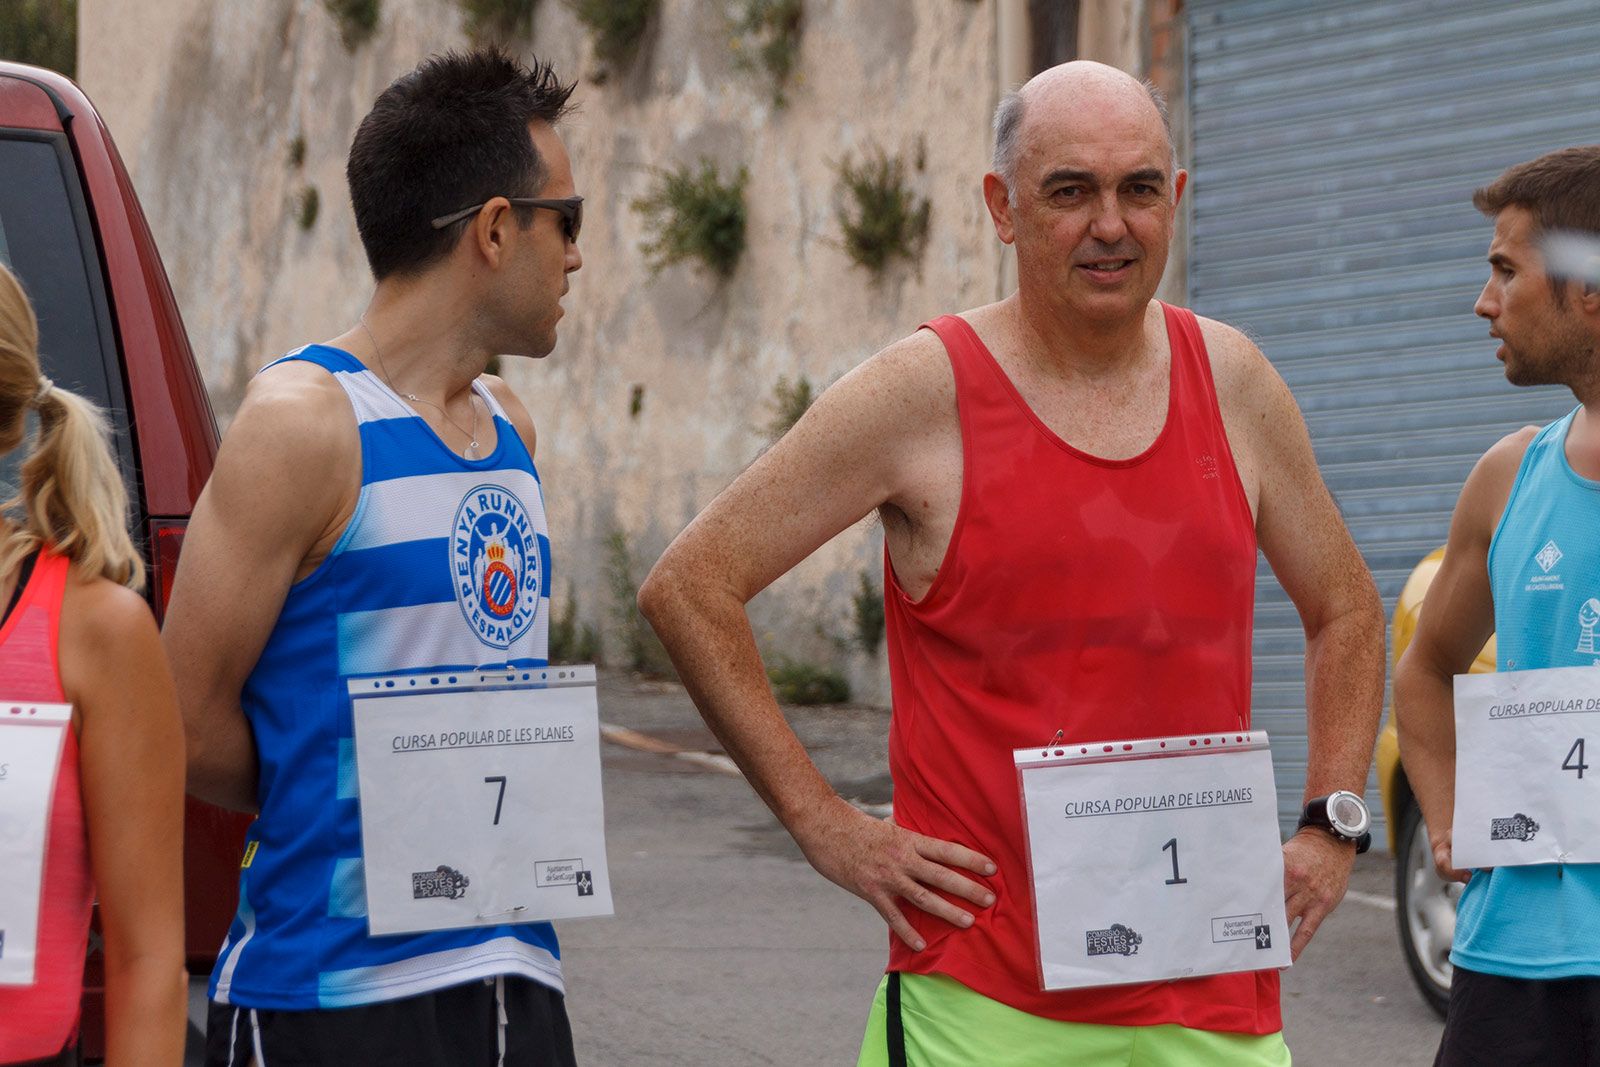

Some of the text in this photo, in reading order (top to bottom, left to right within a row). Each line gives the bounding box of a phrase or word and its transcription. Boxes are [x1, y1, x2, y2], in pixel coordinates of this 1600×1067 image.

[457, 506, 477, 599] PENYA
[478, 493, 537, 592] RUNNERS
[1489, 703, 1526, 718] CURSA
[1528, 699, 1583, 714] POPULAR
[392, 725, 575, 750] CURSA POPULAR DE LES PLANES
[1562, 738, 1589, 779] 4
[484, 776, 507, 825] 7
[1065, 787, 1253, 816] CURSA POPULAR DE LES PLANES
[1162, 838, 1188, 885] 1
[414, 878, 454, 890] FESTES
[422, 887, 454, 897] PLANES
[1088, 935, 1127, 948] FESTES
[1096, 944, 1127, 954] PLANES
